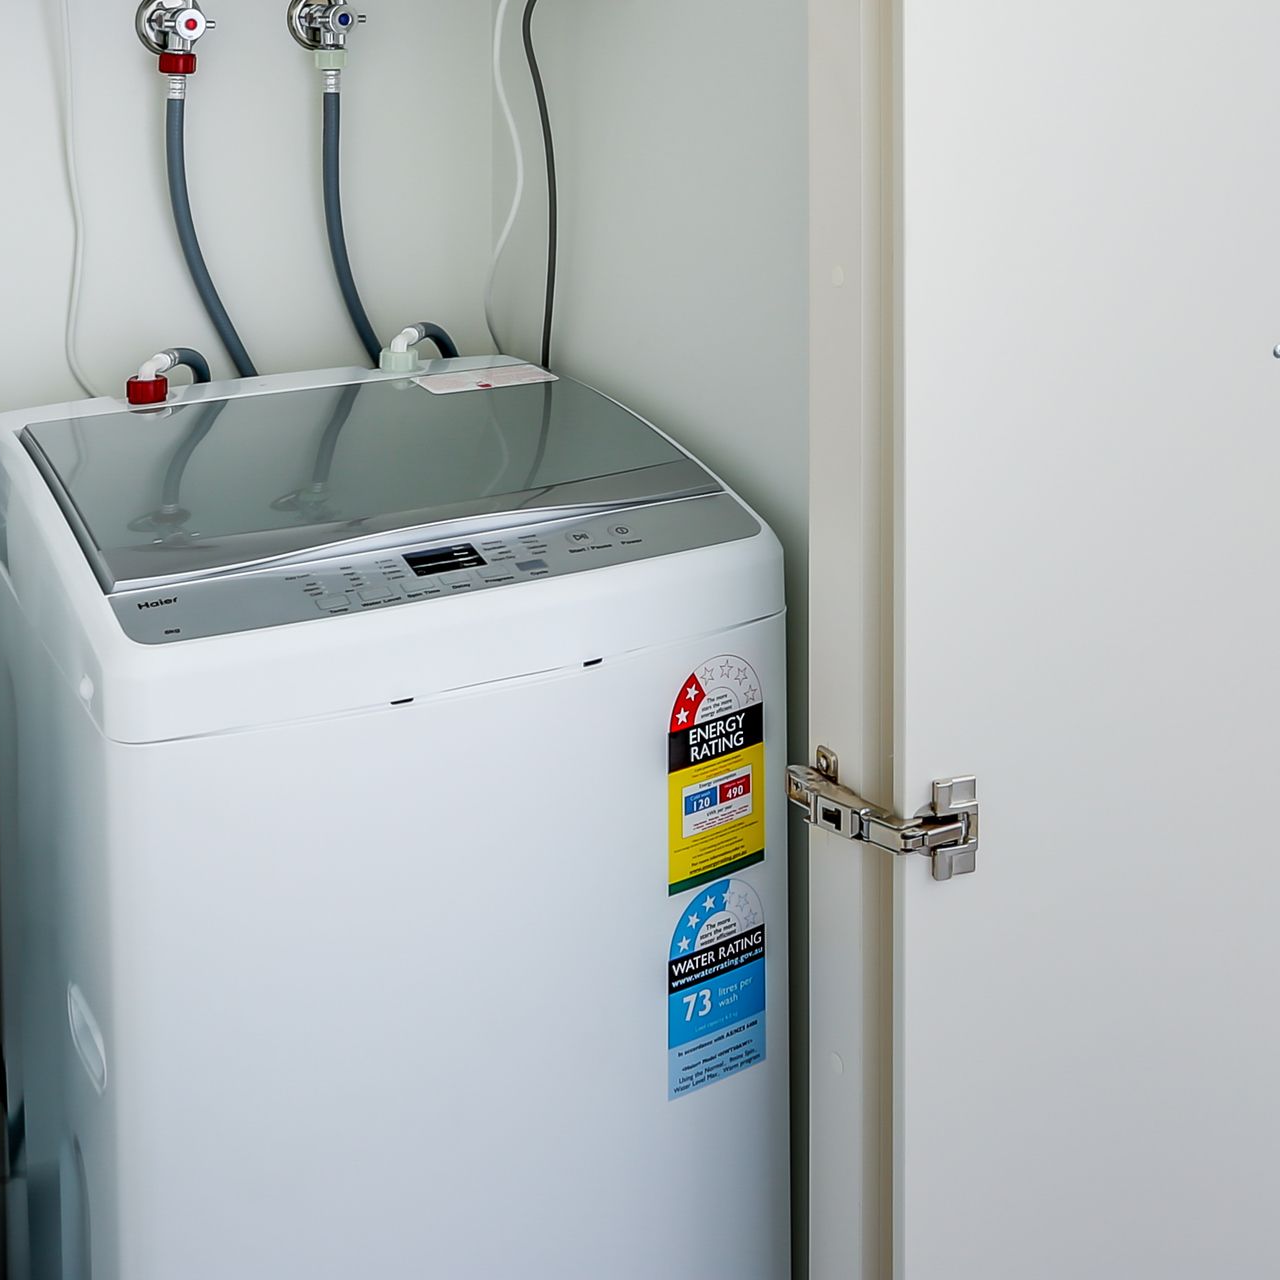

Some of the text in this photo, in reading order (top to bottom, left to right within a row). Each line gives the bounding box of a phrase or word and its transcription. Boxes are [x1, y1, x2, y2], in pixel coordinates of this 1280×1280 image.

[137, 596, 178, 610] Haier
[689, 712, 746, 745] ENERGY
[690, 731, 744, 762] RATING
[726, 785, 744, 799] 490
[693, 797, 710, 812] 120
[706, 923, 715, 931] The
[723, 922, 736, 930] more
[672, 931, 762, 977] WATER RATING
[672, 946, 763, 988] www.waterrating.gov.au
[718, 977, 752, 996] litres per
[683, 989, 712, 1022] 73
[718, 993, 738, 1007] wash
[673, 1084, 690, 1094] Water
[692, 1078, 706, 1087] Level
[739, 1053, 761, 1067] program
[679, 1075, 693, 1084] Using
